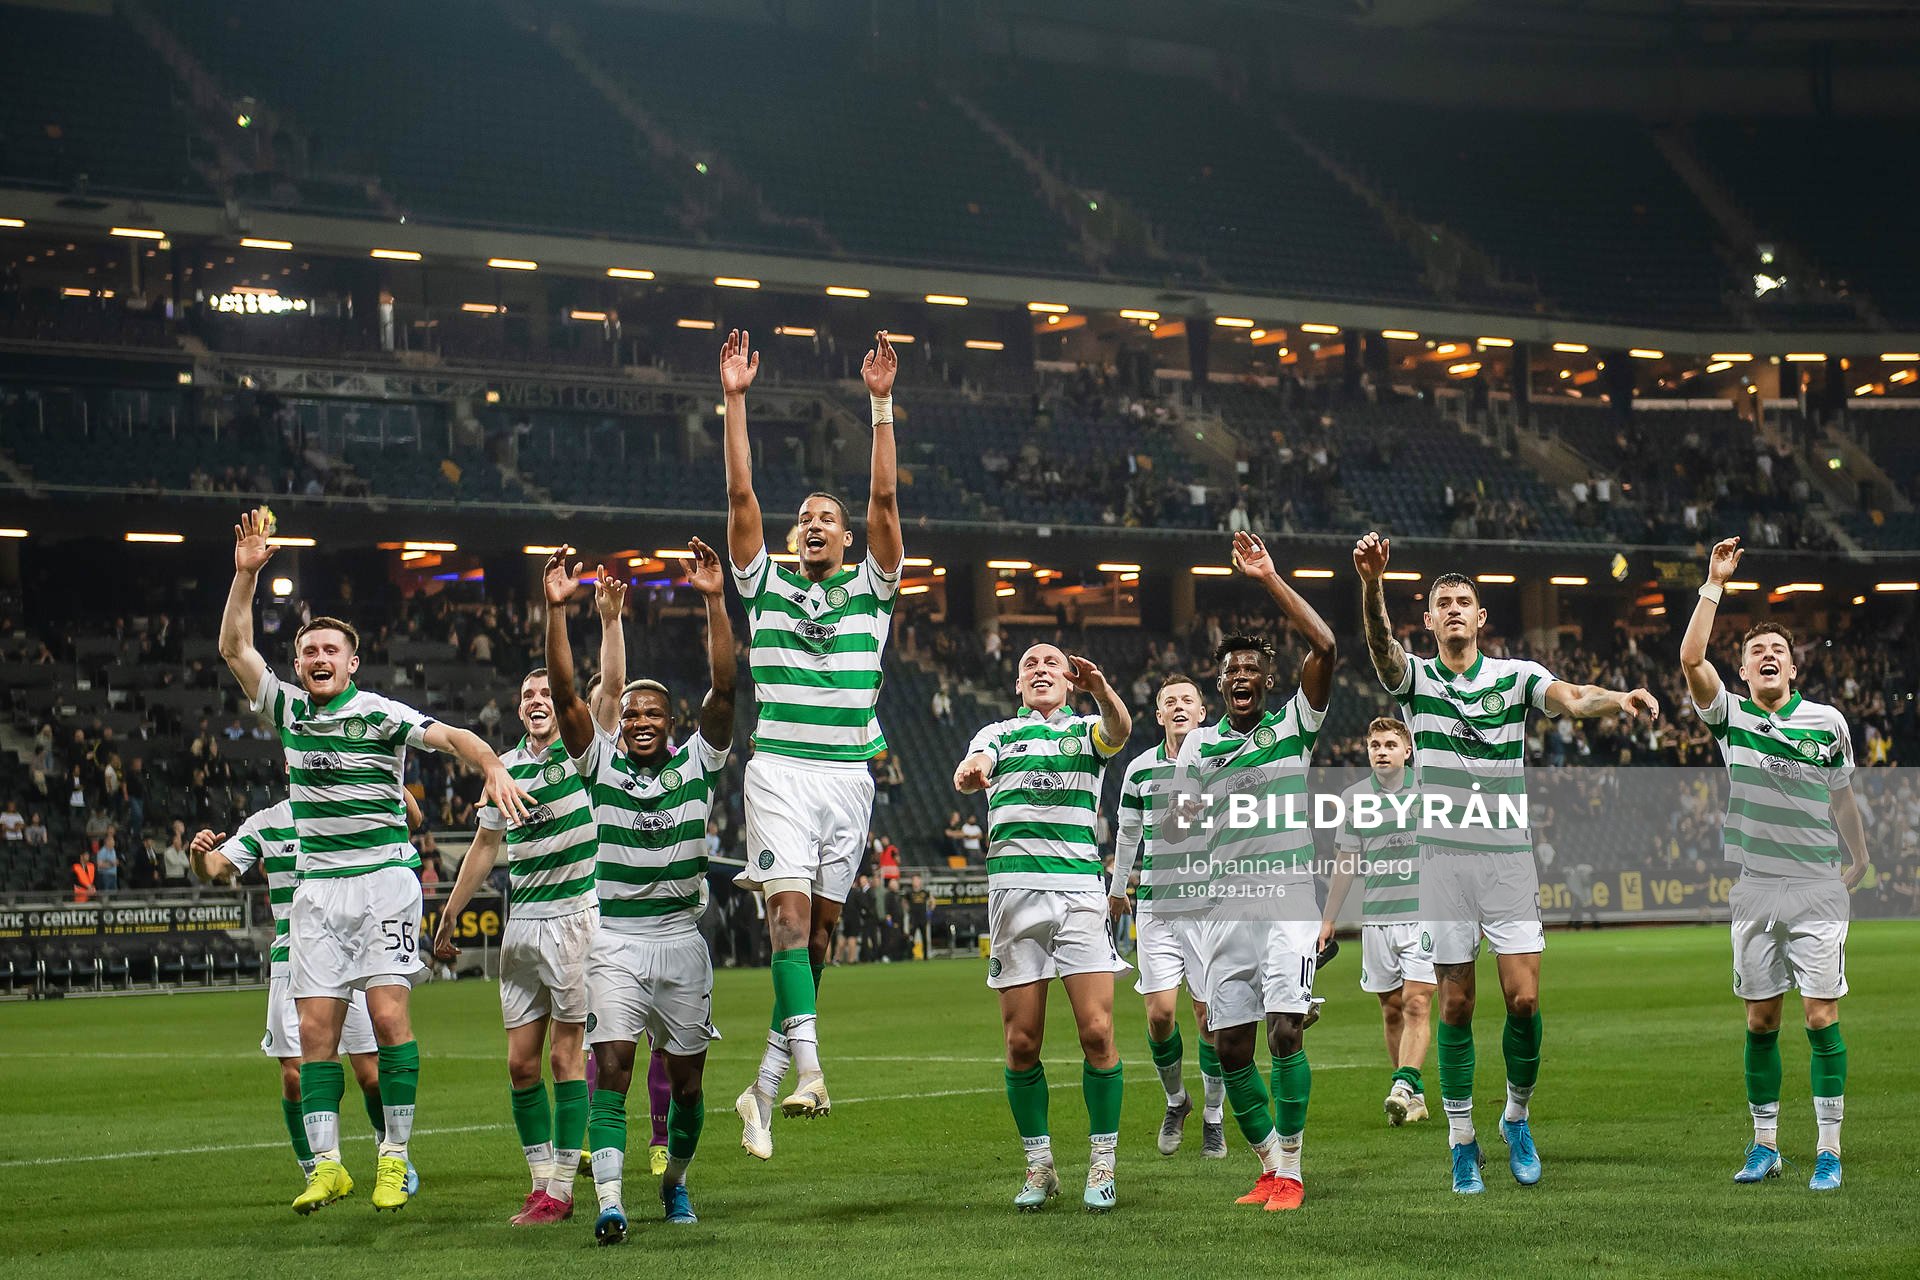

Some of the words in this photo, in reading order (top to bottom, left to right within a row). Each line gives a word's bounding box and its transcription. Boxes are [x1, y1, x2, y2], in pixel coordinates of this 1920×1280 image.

[42, 910, 99, 927] centric
[116, 908, 171, 924] centric
[188, 905, 242, 923] centric
[381, 919, 416, 953] 56
[1300, 955, 1313, 990] 10
